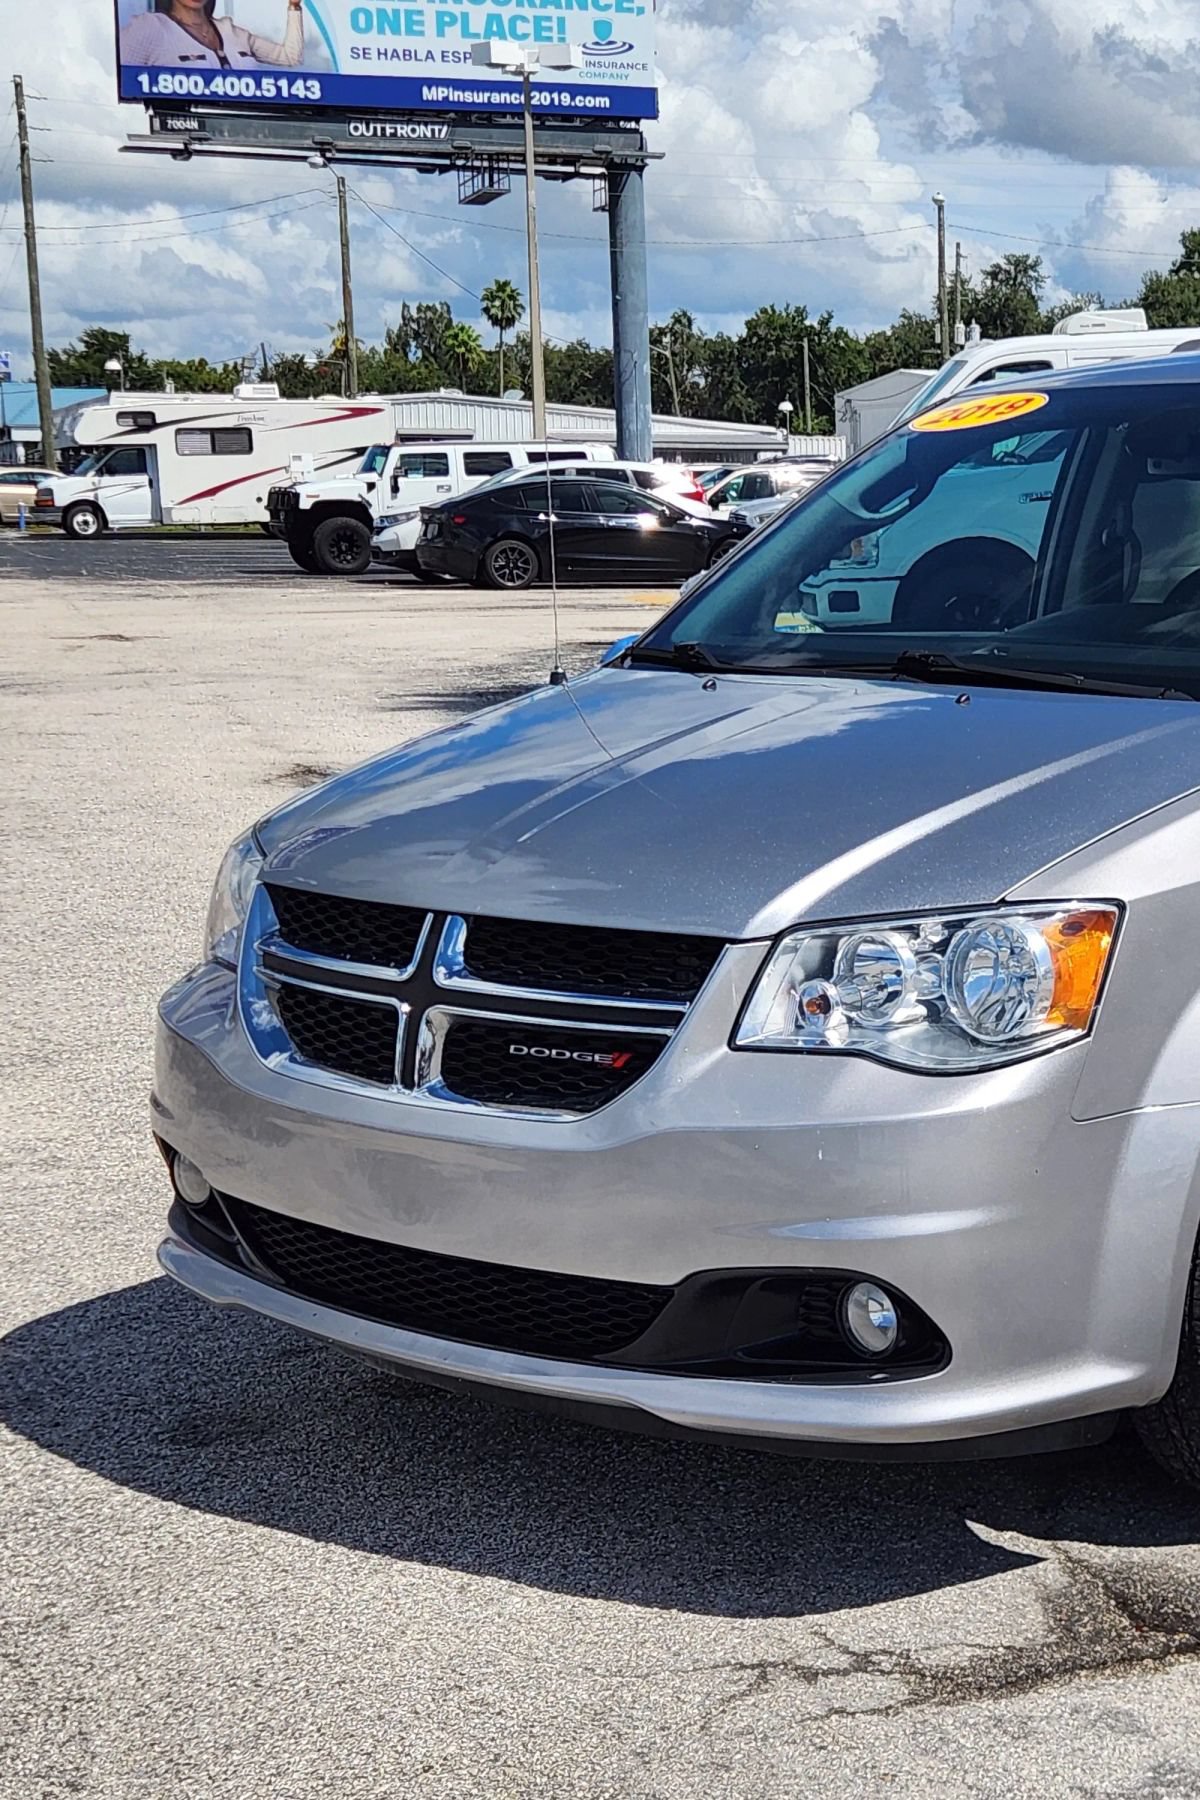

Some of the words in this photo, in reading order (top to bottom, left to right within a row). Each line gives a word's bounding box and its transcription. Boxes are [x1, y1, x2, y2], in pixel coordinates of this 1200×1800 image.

[350, 7, 425, 36] ONE
[435, 11, 567, 42] PLACE!
[350, 46, 372, 60] SE
[377, 48, 436, 63] HABLA
[578, 71, 630, 81] COMPANY
[585, 60, 649, 71] INSURANCE
[137, 72, 321, 99] 1.800.400.5143
[422, 85, 610, 108] MPInsuranc2019.com
[919, 397, 1035, 426] 2019
[509, 1044, 614, 1063] DODGE
